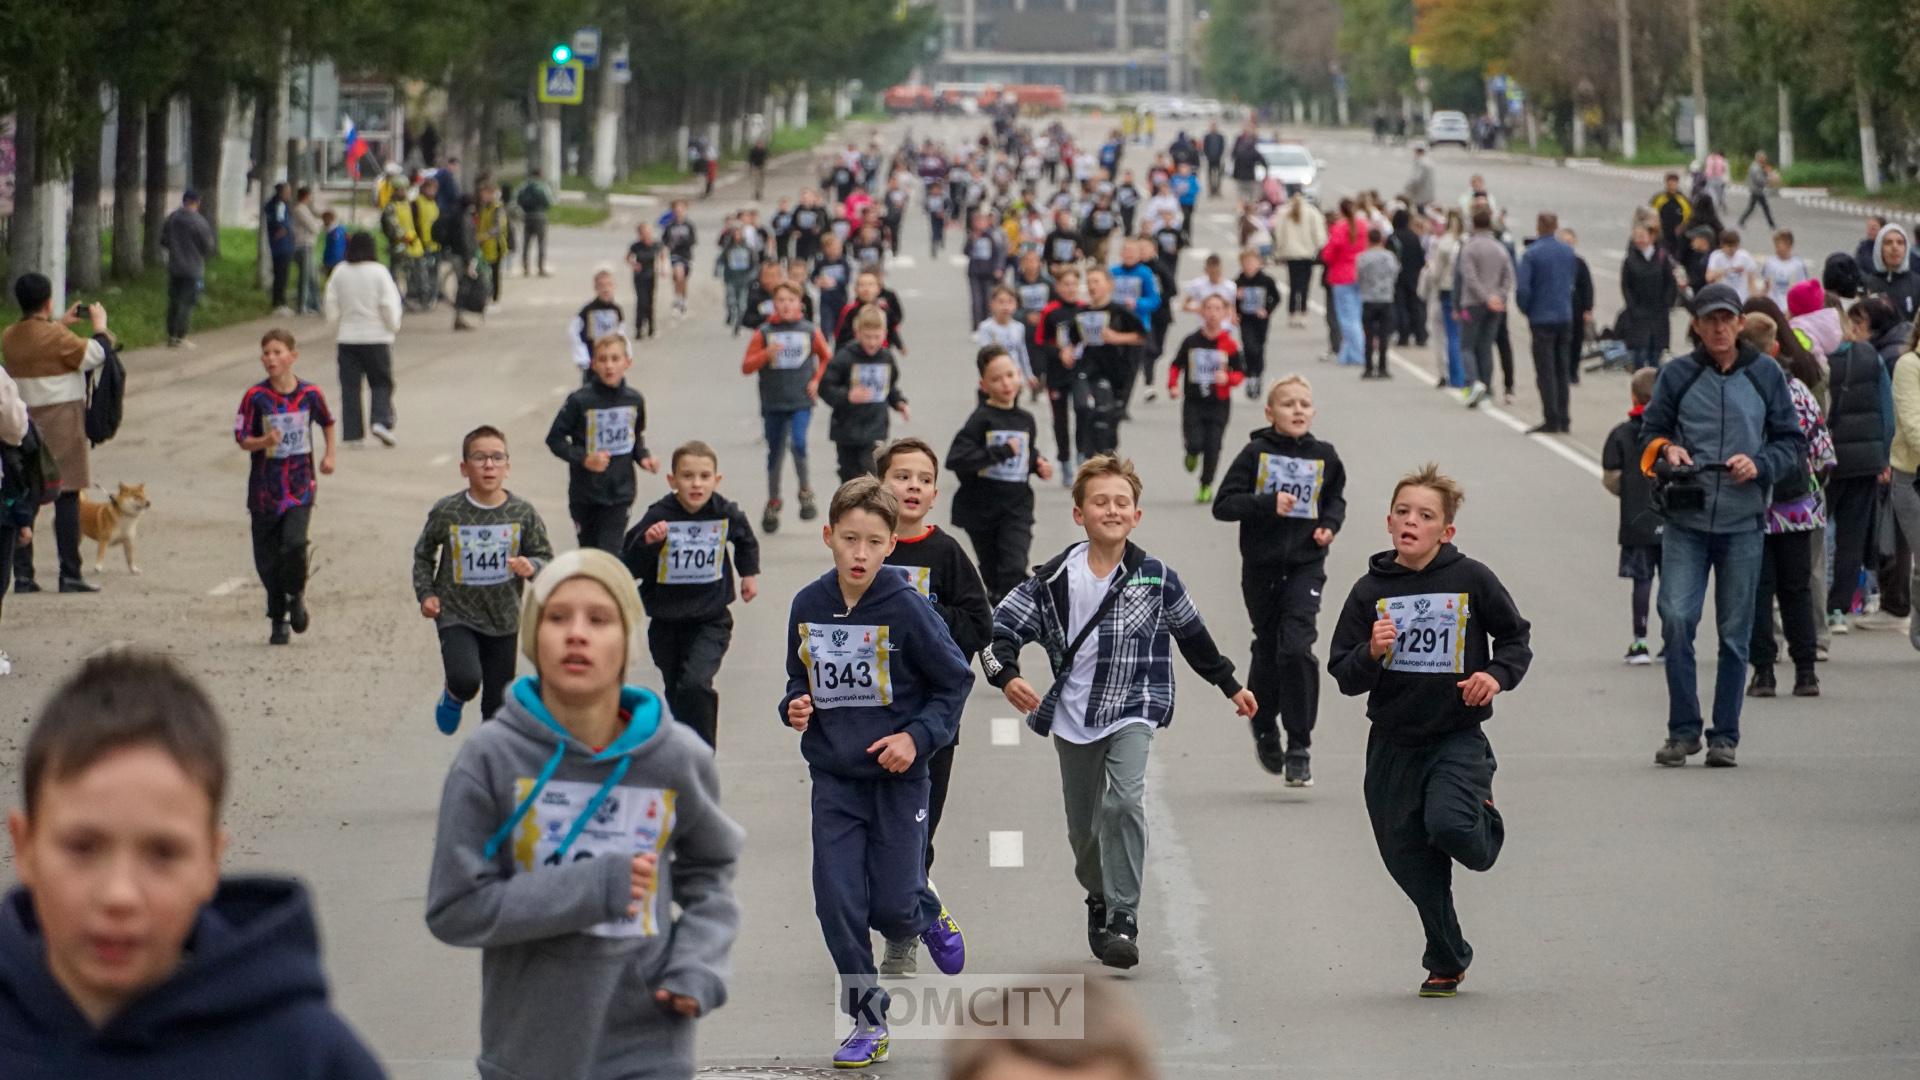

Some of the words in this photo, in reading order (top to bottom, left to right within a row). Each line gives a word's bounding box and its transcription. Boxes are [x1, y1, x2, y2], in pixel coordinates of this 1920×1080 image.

[466, 551, 507, 571] 1441
[672, 548, 715, 569] 1704
[1397, 628, 1450, 654] 1291
[813, 661, 872, 689] 1343
